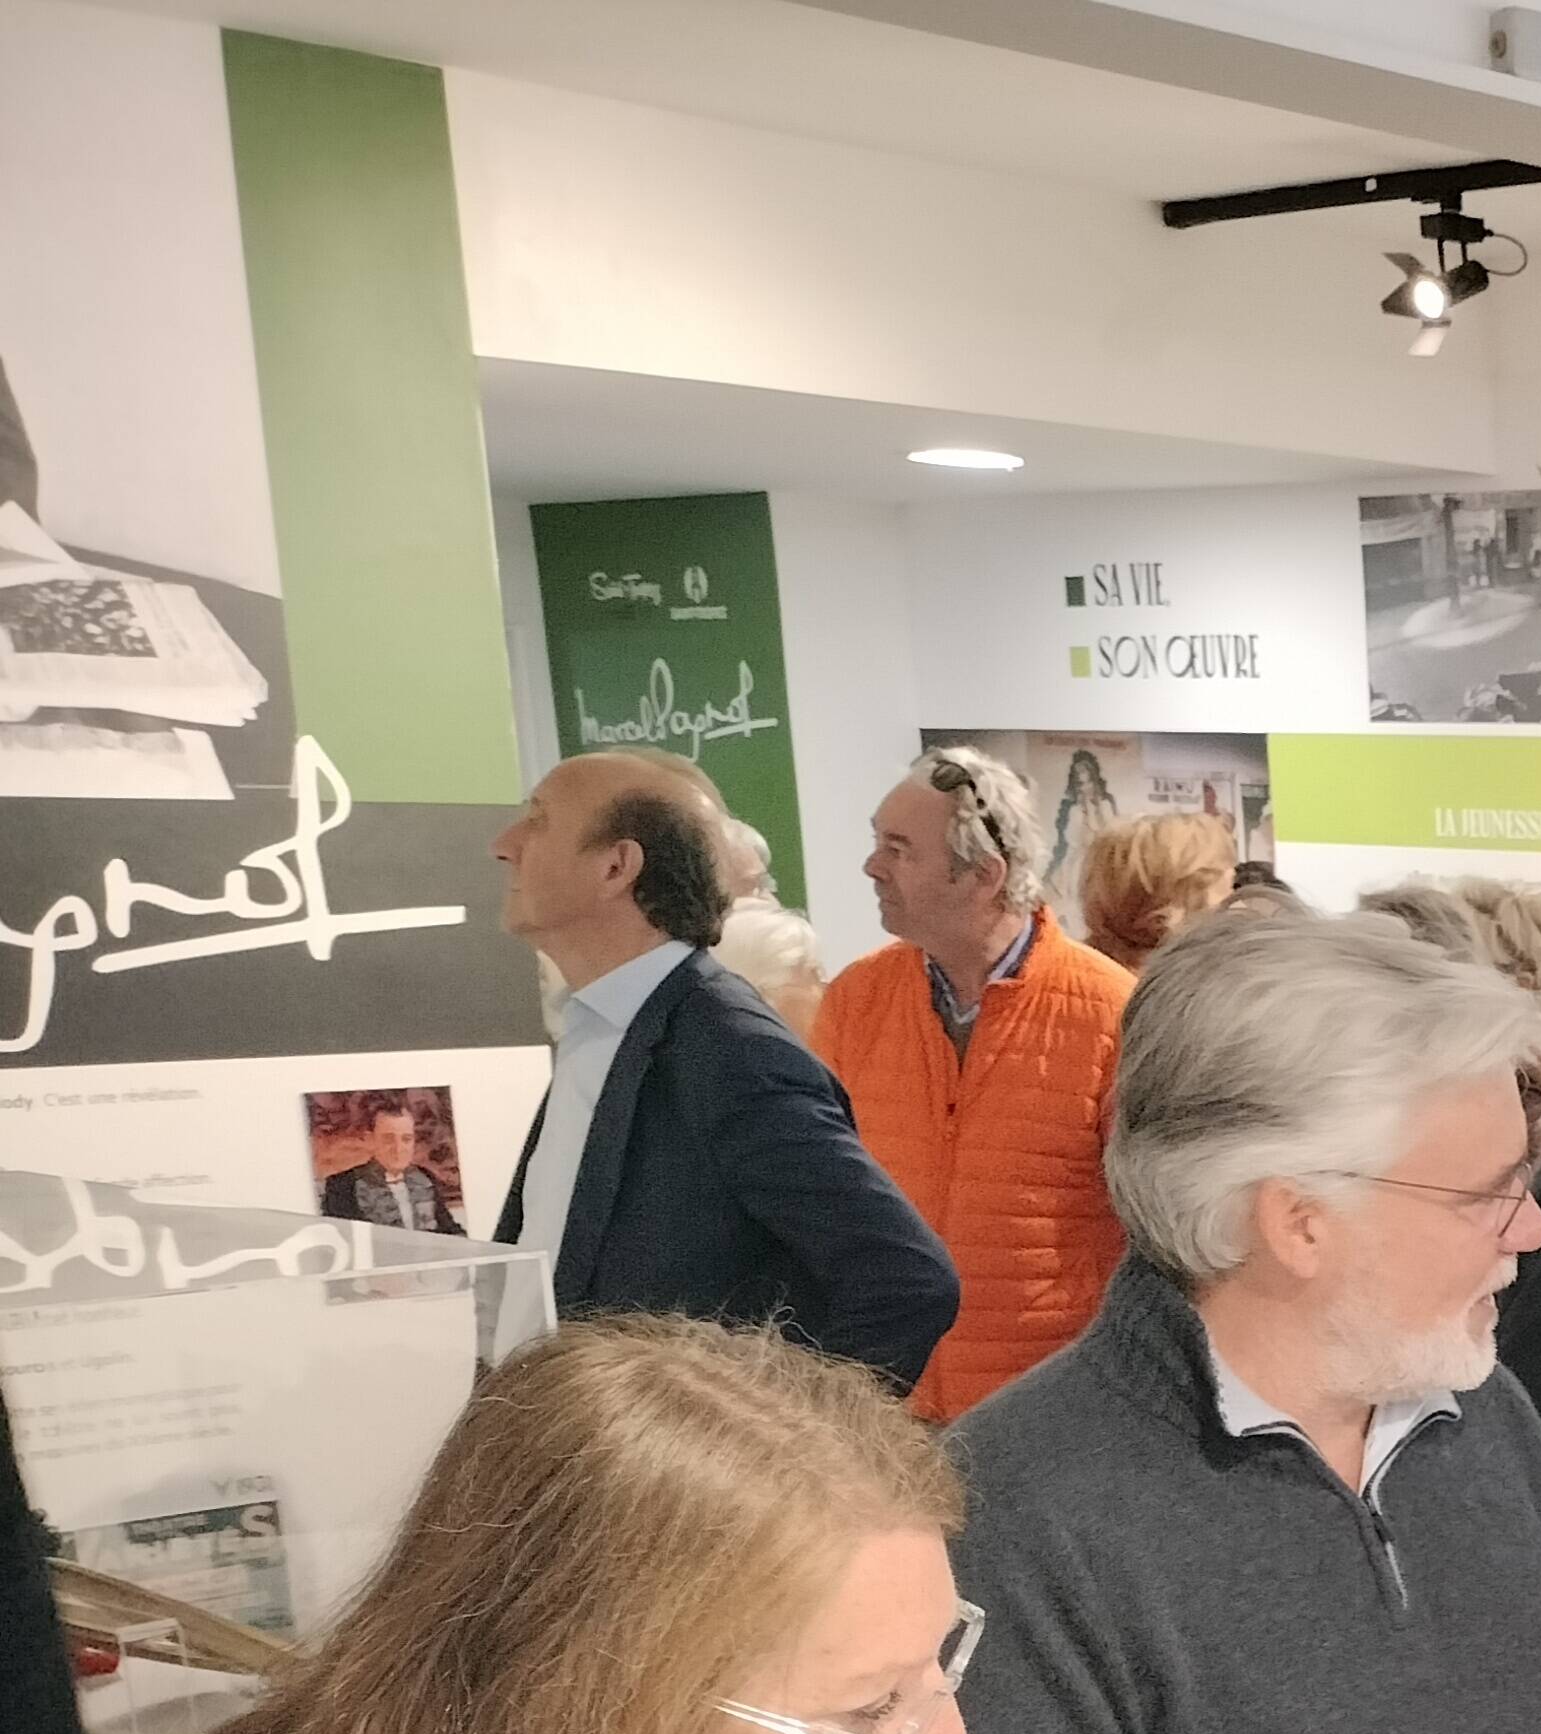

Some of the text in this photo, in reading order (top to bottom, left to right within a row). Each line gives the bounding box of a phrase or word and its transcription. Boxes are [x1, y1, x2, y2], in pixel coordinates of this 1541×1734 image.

[1092, 562, 1124, 607] SA
[1097, 635, 1159, 679] SON
[1435, 808, 1457, 837] LA
